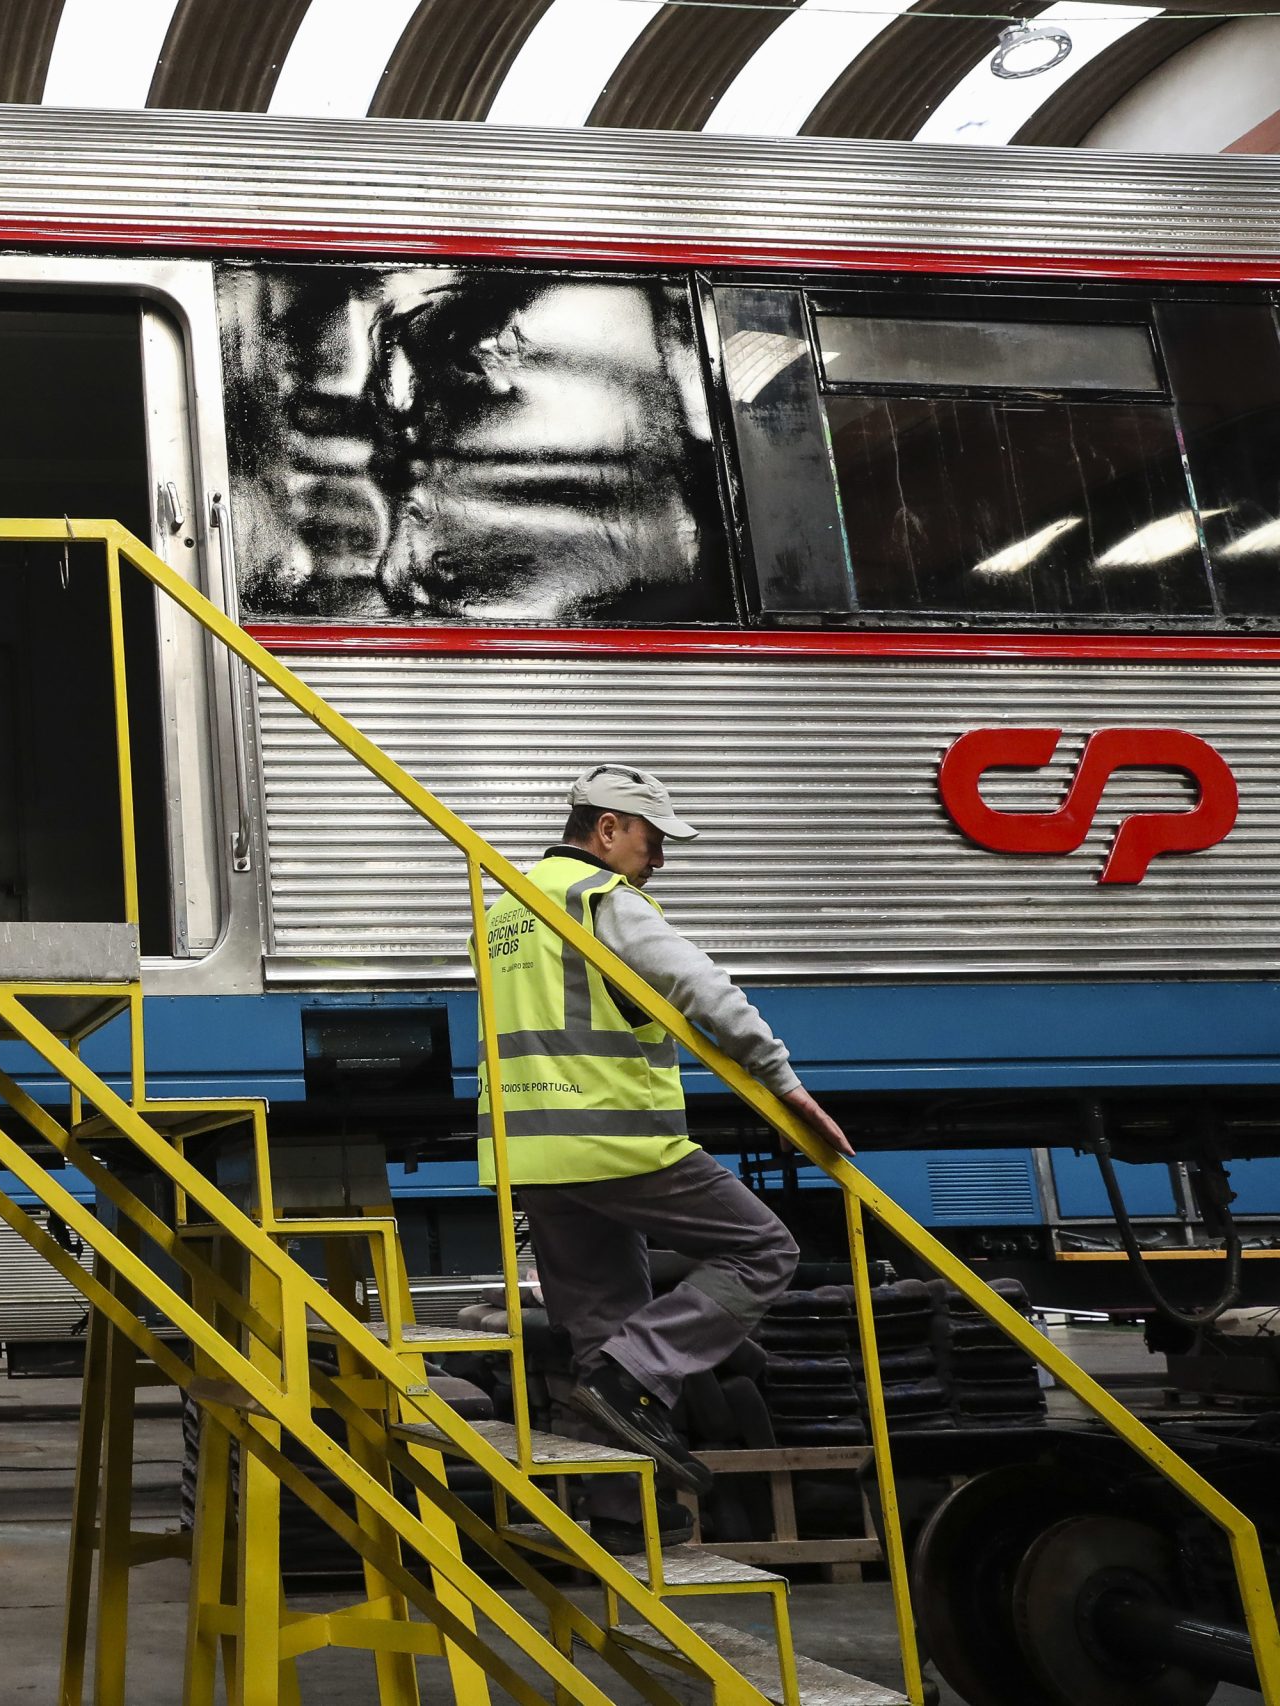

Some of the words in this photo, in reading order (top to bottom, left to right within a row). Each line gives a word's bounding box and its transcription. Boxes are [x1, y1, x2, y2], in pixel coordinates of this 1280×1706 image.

[938, 727, 1239, 885] CP
[487, 922, 518, 945] OFICINA
[521, 918, 536, 934] DE
[522, 1083, 530, 1092] DE
[531, 1082, 583, 1094] PORTUGAL
